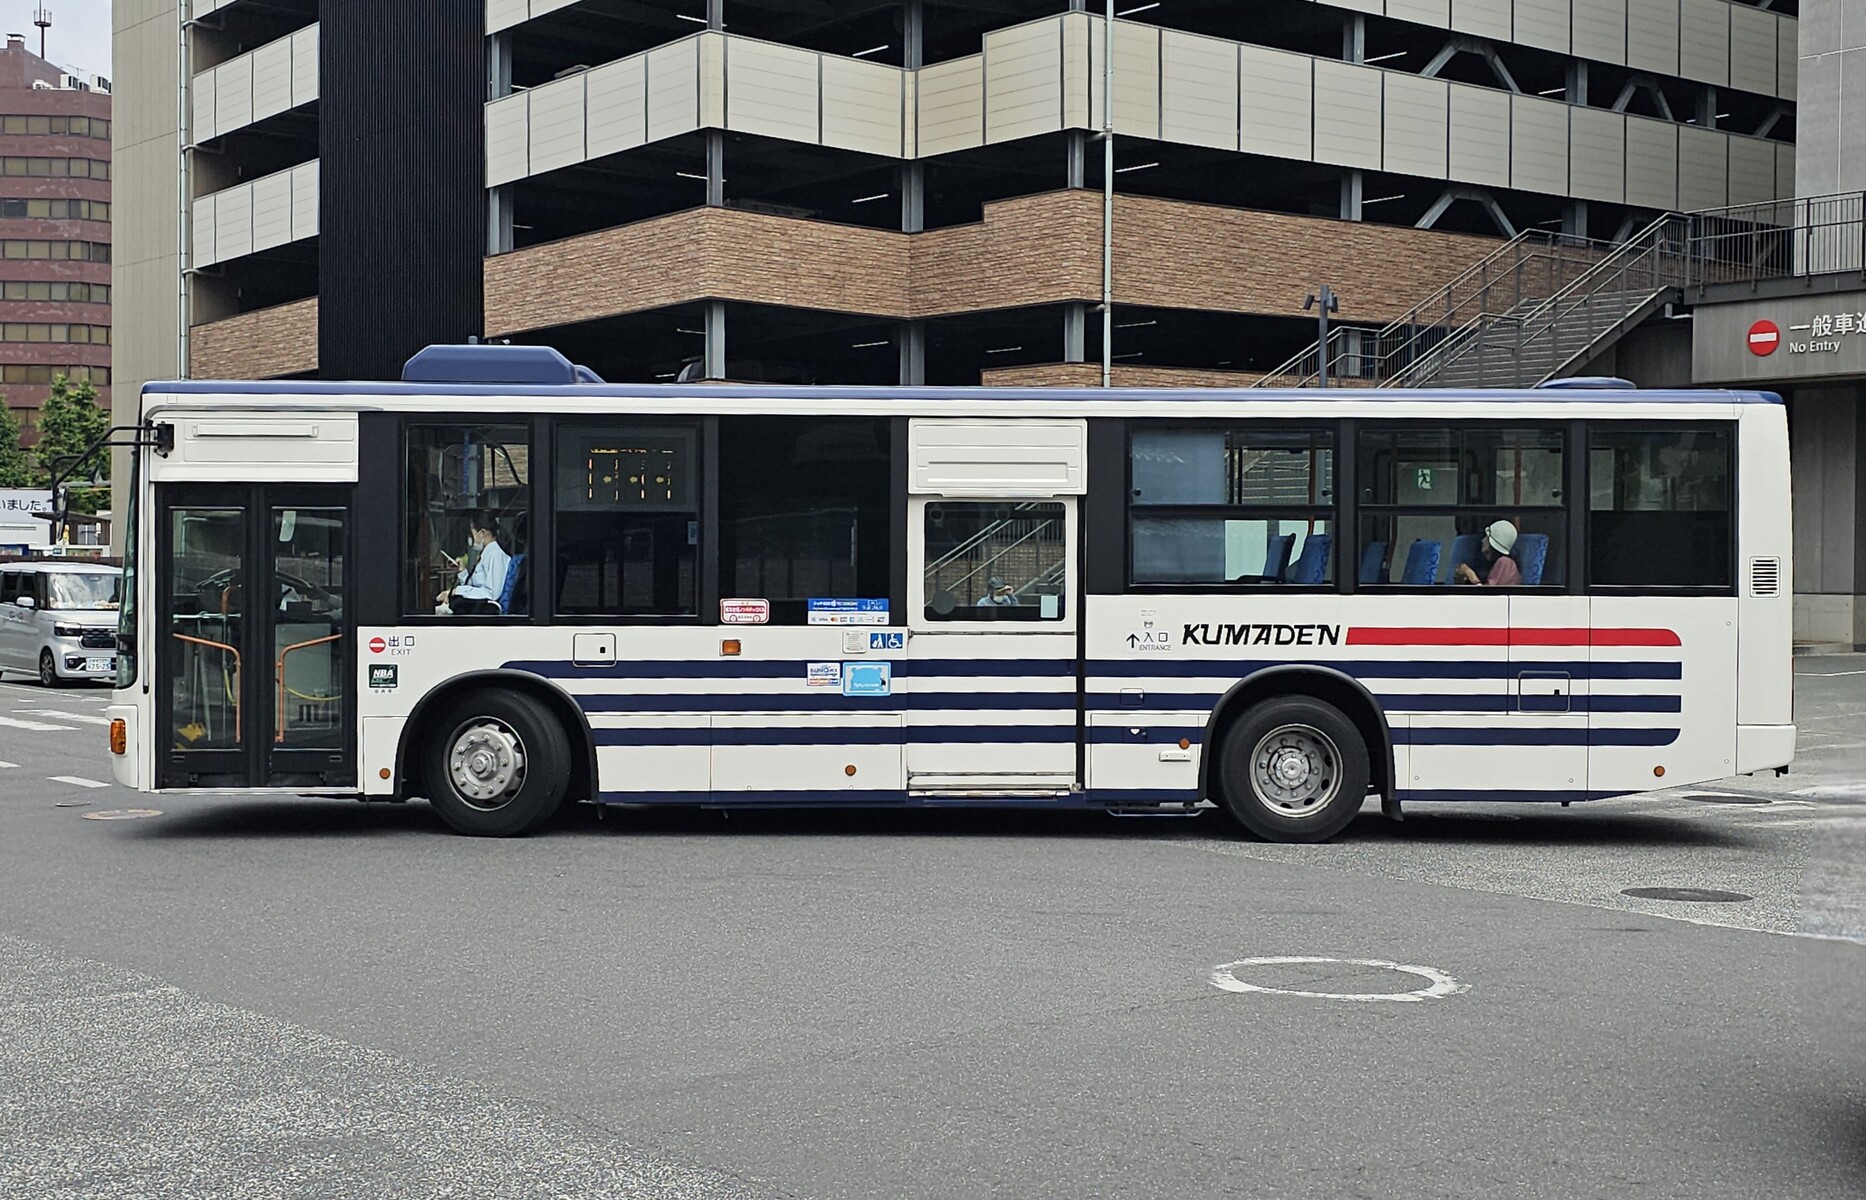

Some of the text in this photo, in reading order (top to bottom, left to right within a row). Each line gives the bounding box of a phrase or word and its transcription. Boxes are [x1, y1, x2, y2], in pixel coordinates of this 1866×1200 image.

[1789, 340, 1841, 353] No Entry
[1143, 631, 1169, 643] 入口
[1181, 624, 1341, 645] KUMADEN
[388, 635, 415, 647] 出口
[373, 669, 394, 679] NBA
